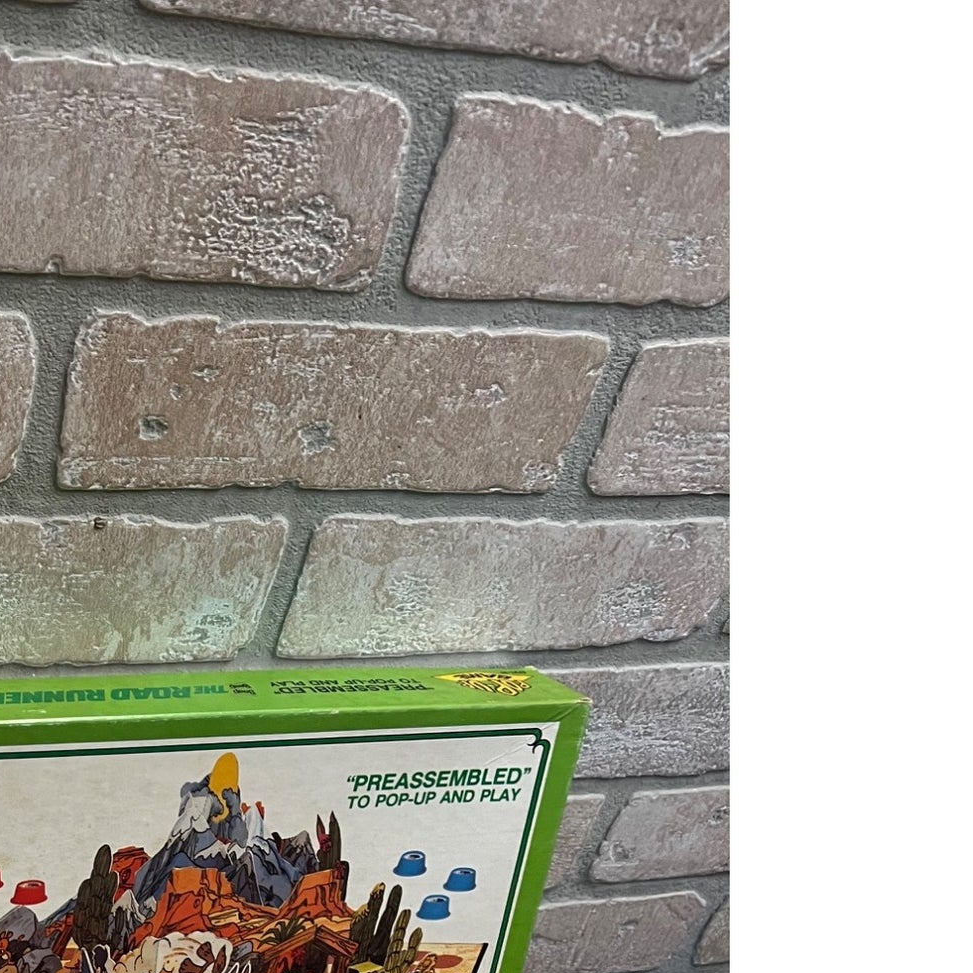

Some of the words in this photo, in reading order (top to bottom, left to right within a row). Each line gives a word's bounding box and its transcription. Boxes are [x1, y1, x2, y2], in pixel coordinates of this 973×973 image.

[110, 686, 192, 701] ROAD
[194, 684, 229, 695] THE
[347, 795, 370, 809] TO
[375, 791, 436, 808] POP-UP
[439, 790, 475, 804] AND
[480, 788, 522, 803] PLAY
